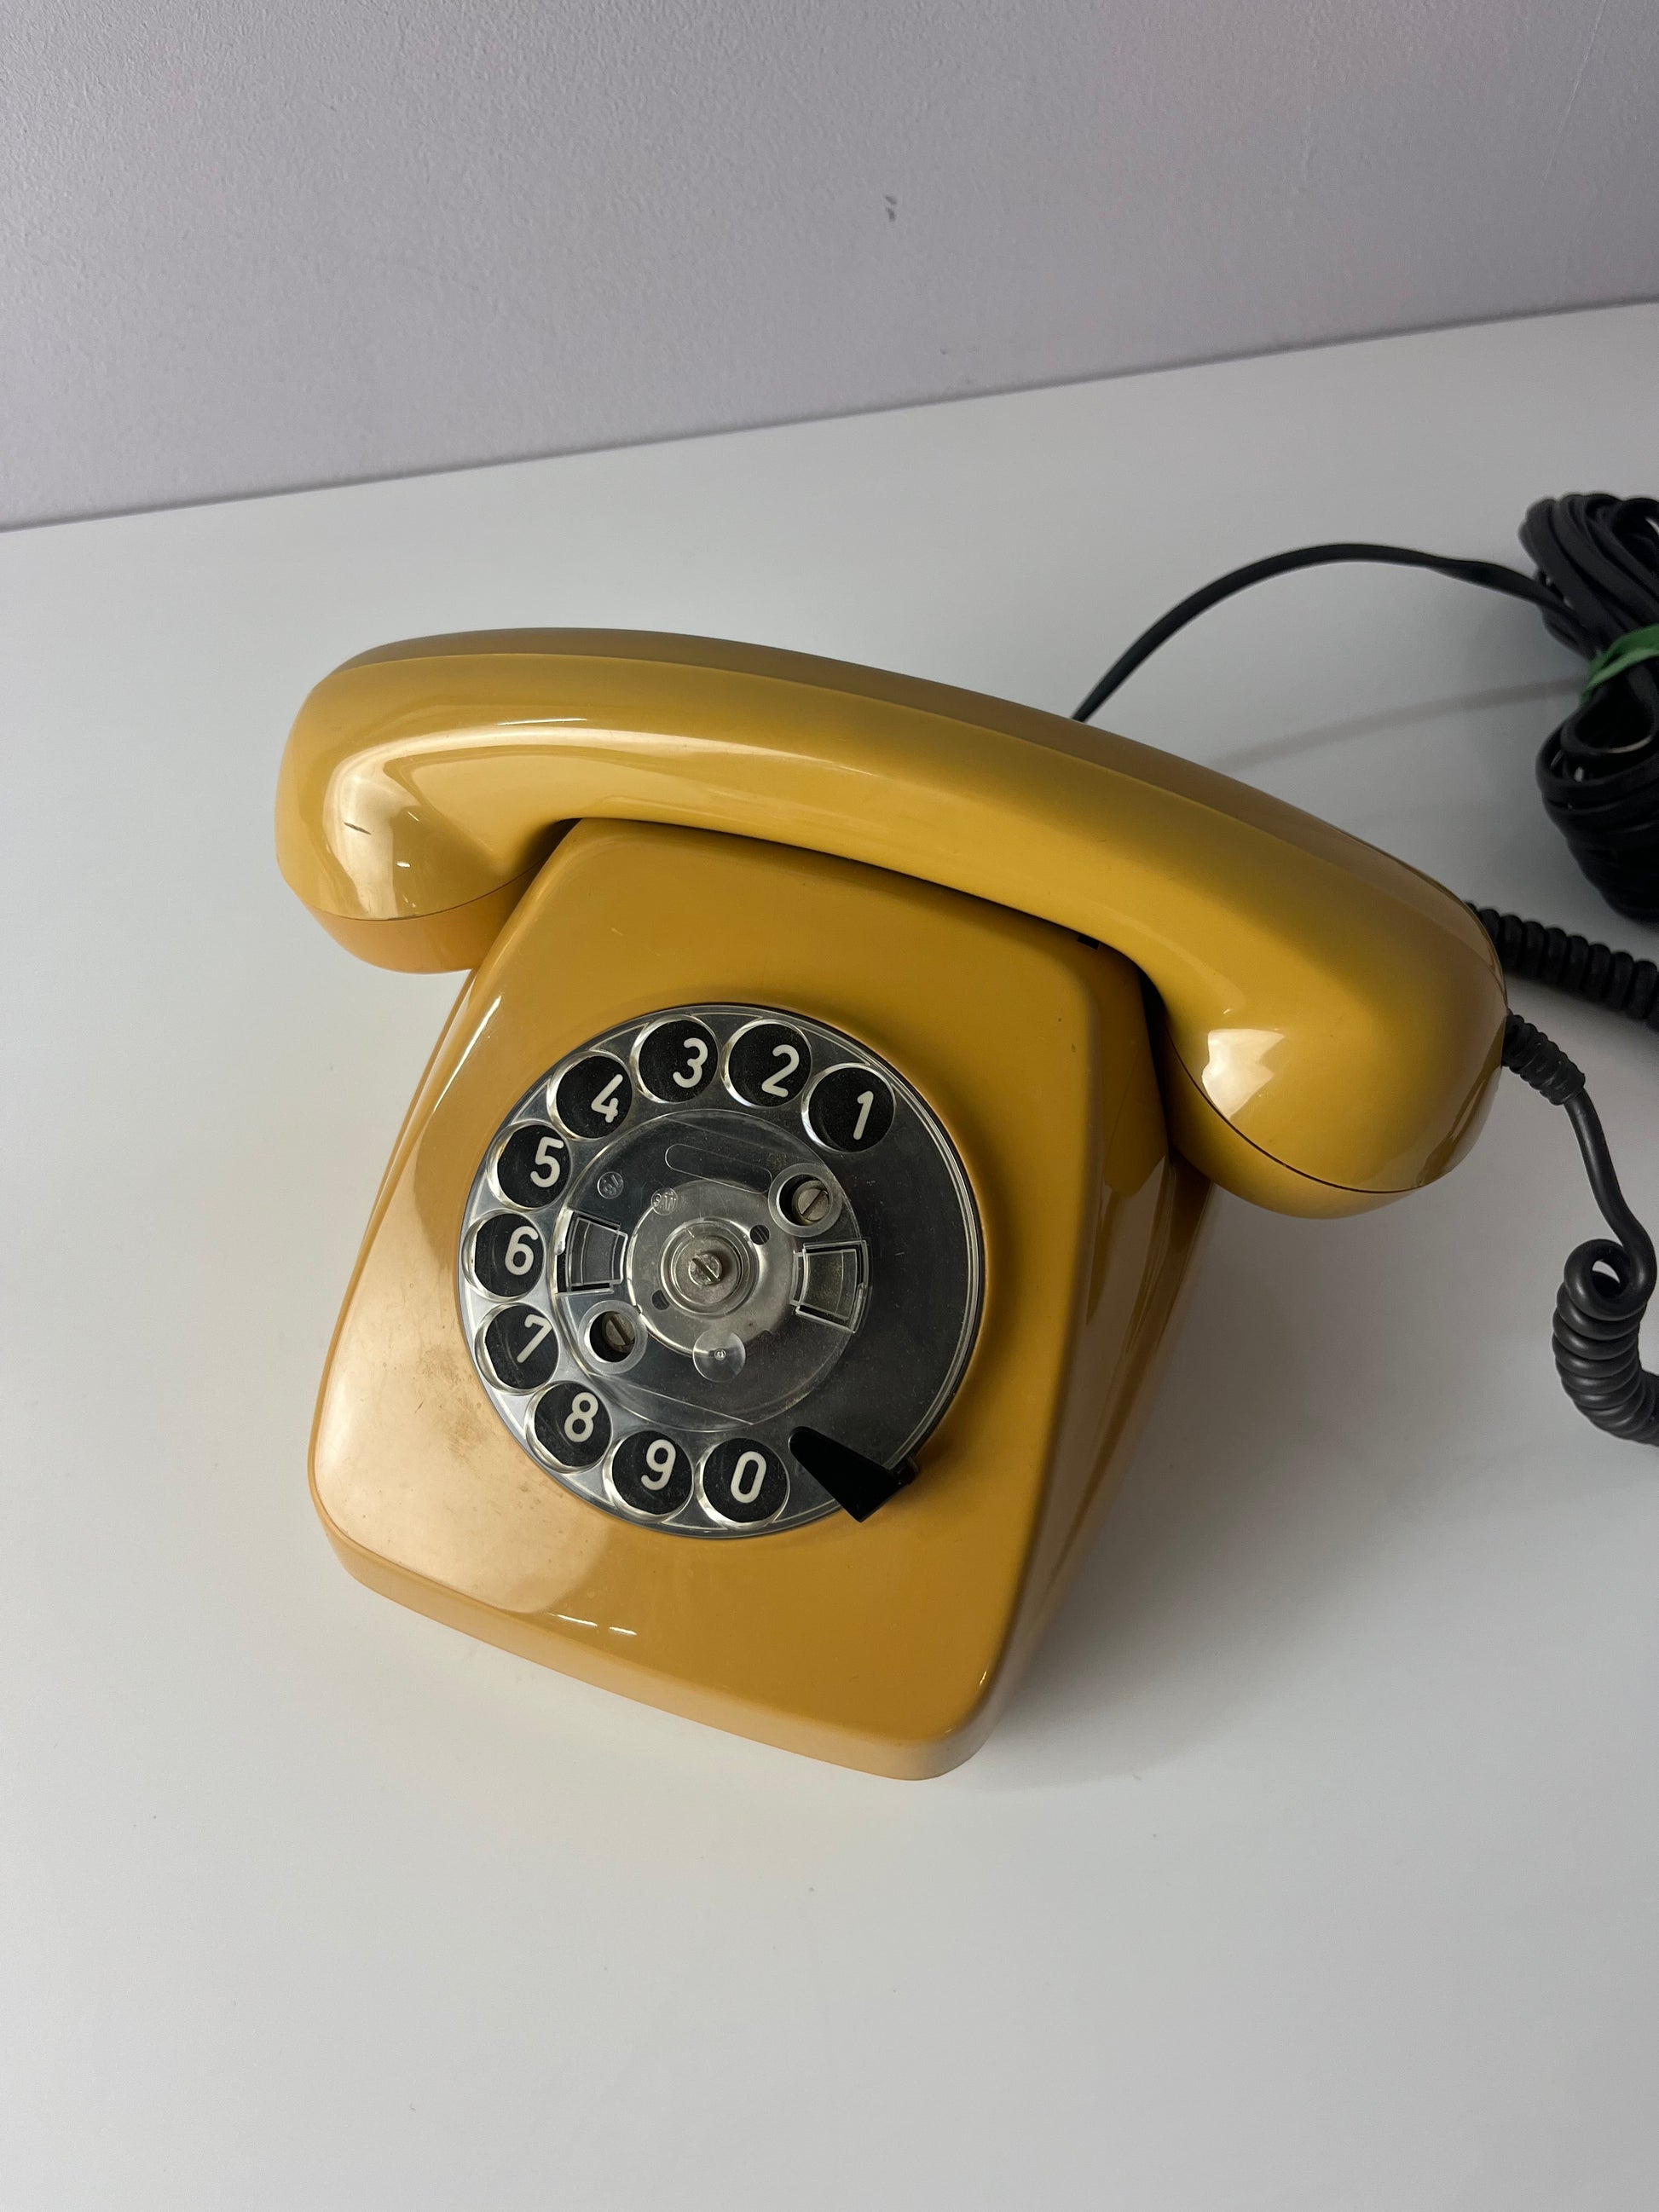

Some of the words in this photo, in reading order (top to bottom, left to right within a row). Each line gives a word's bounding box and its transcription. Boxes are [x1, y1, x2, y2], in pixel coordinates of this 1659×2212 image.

[673, 1037, 709, 1089] 3
[761, 1044, 800, 1098] 2
[591, 1074, 624, 1123] 4
[853, 1090, 875, 1140] 1
[530, 1136, 564, 1187] 5
[505, 1226, 539, 1275] 6
[517, 1313, 552, 1363] 7
[564, 1392, 598, 1442] 8
[640, 1439, 676, 1490] 9
[730, 1451, 767, 1504] 0
